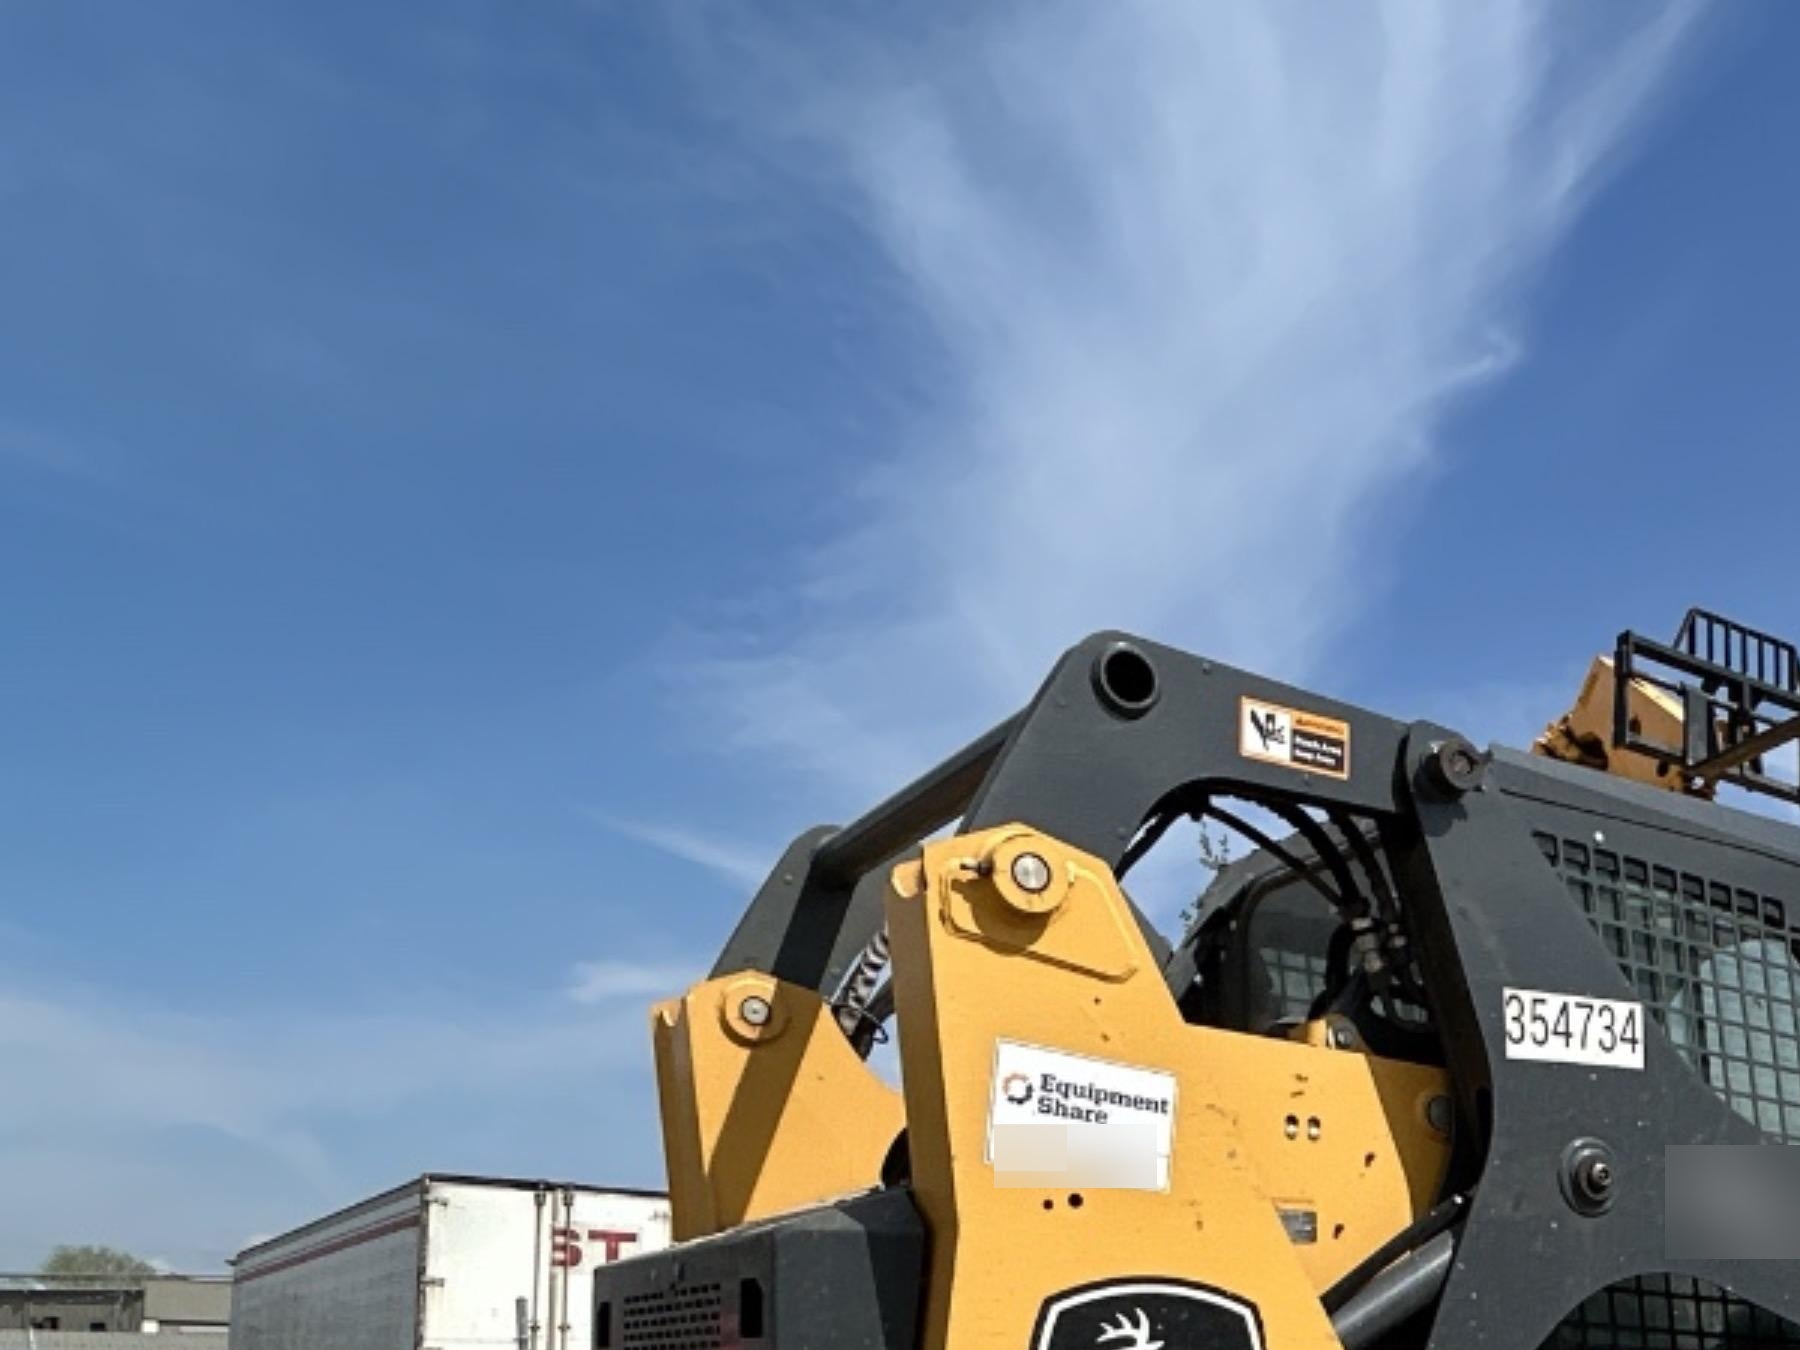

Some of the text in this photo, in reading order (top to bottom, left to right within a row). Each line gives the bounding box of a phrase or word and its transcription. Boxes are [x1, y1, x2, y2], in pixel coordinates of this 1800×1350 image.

[1506, 994, 1639, 1053] 354734
[1037, 1095, 1108, 1125] Share
[1040, 1073, 1169, 1114] Equipment
